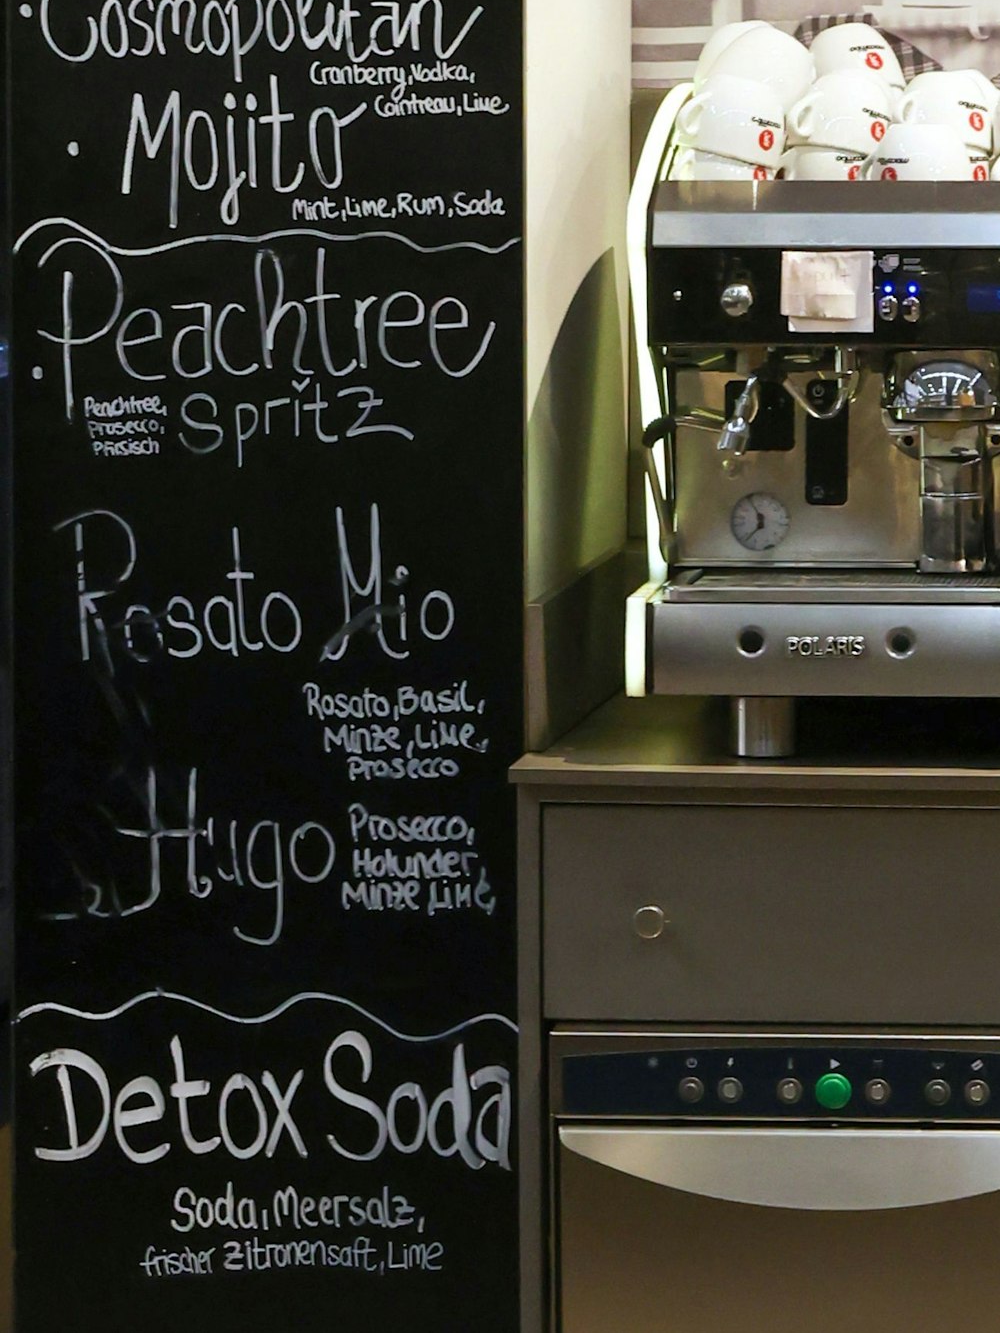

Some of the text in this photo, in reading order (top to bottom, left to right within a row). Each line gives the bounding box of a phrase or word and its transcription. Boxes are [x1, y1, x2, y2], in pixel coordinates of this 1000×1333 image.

[121, 74, 368, 229] Mojito
[37, 237, 496, 422] Peachtree
[53, 503, 456, 677] Rosato Mio
[786, 635, 865, 657] POLARIS
[100, 767, 336, 946] Hugo
[29, 1030, 512, 1171] Detox Soda
[387, 1240, 444, 1270] Lime
